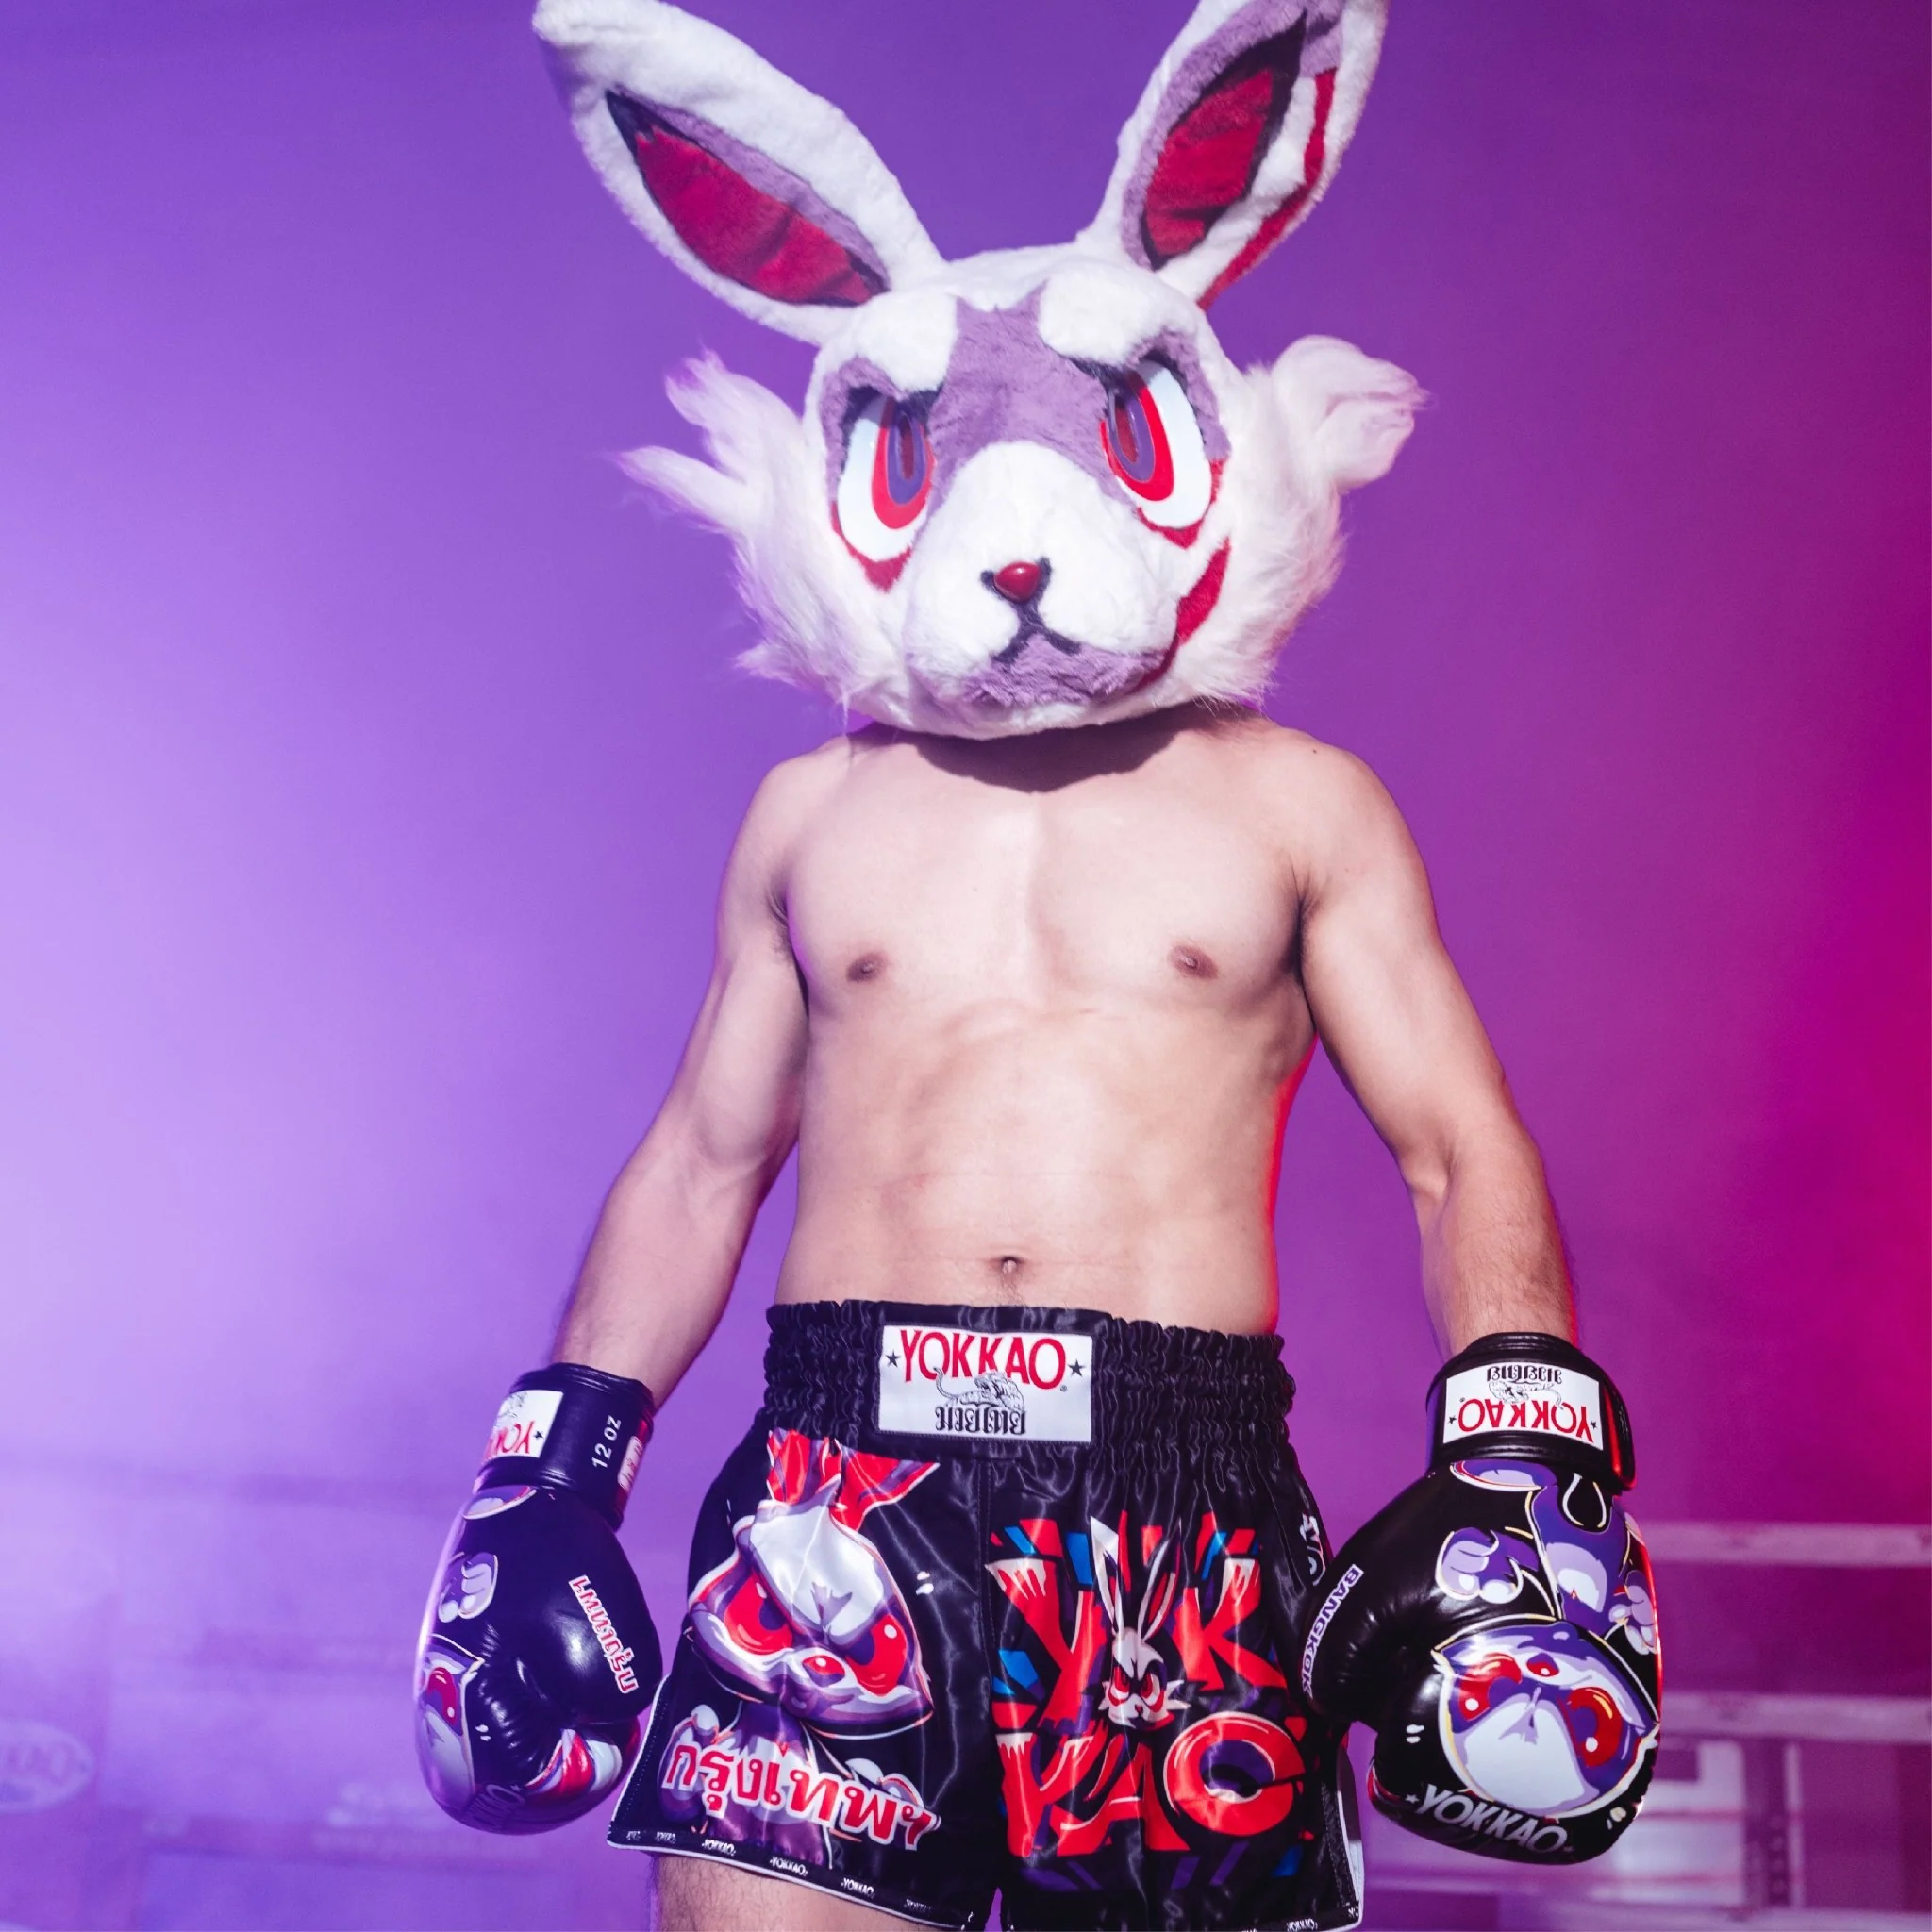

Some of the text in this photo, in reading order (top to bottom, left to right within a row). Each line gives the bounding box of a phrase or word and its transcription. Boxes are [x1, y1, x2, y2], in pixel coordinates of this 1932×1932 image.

[900, 1329, 1066, 1390] YOKKAO
[1457, 1398, 1593, 1443] YOKKAO
[591, 1442, 612, 1469] 12
[1300, 1564, 1364, 1699] BANGKOK
[661, 1743, 939, 1851] กรุงเทพฯ
[1415, 1784, 1568, 1854] YOKKAO
[772, 1856, 806, 1876] YOKKAO
